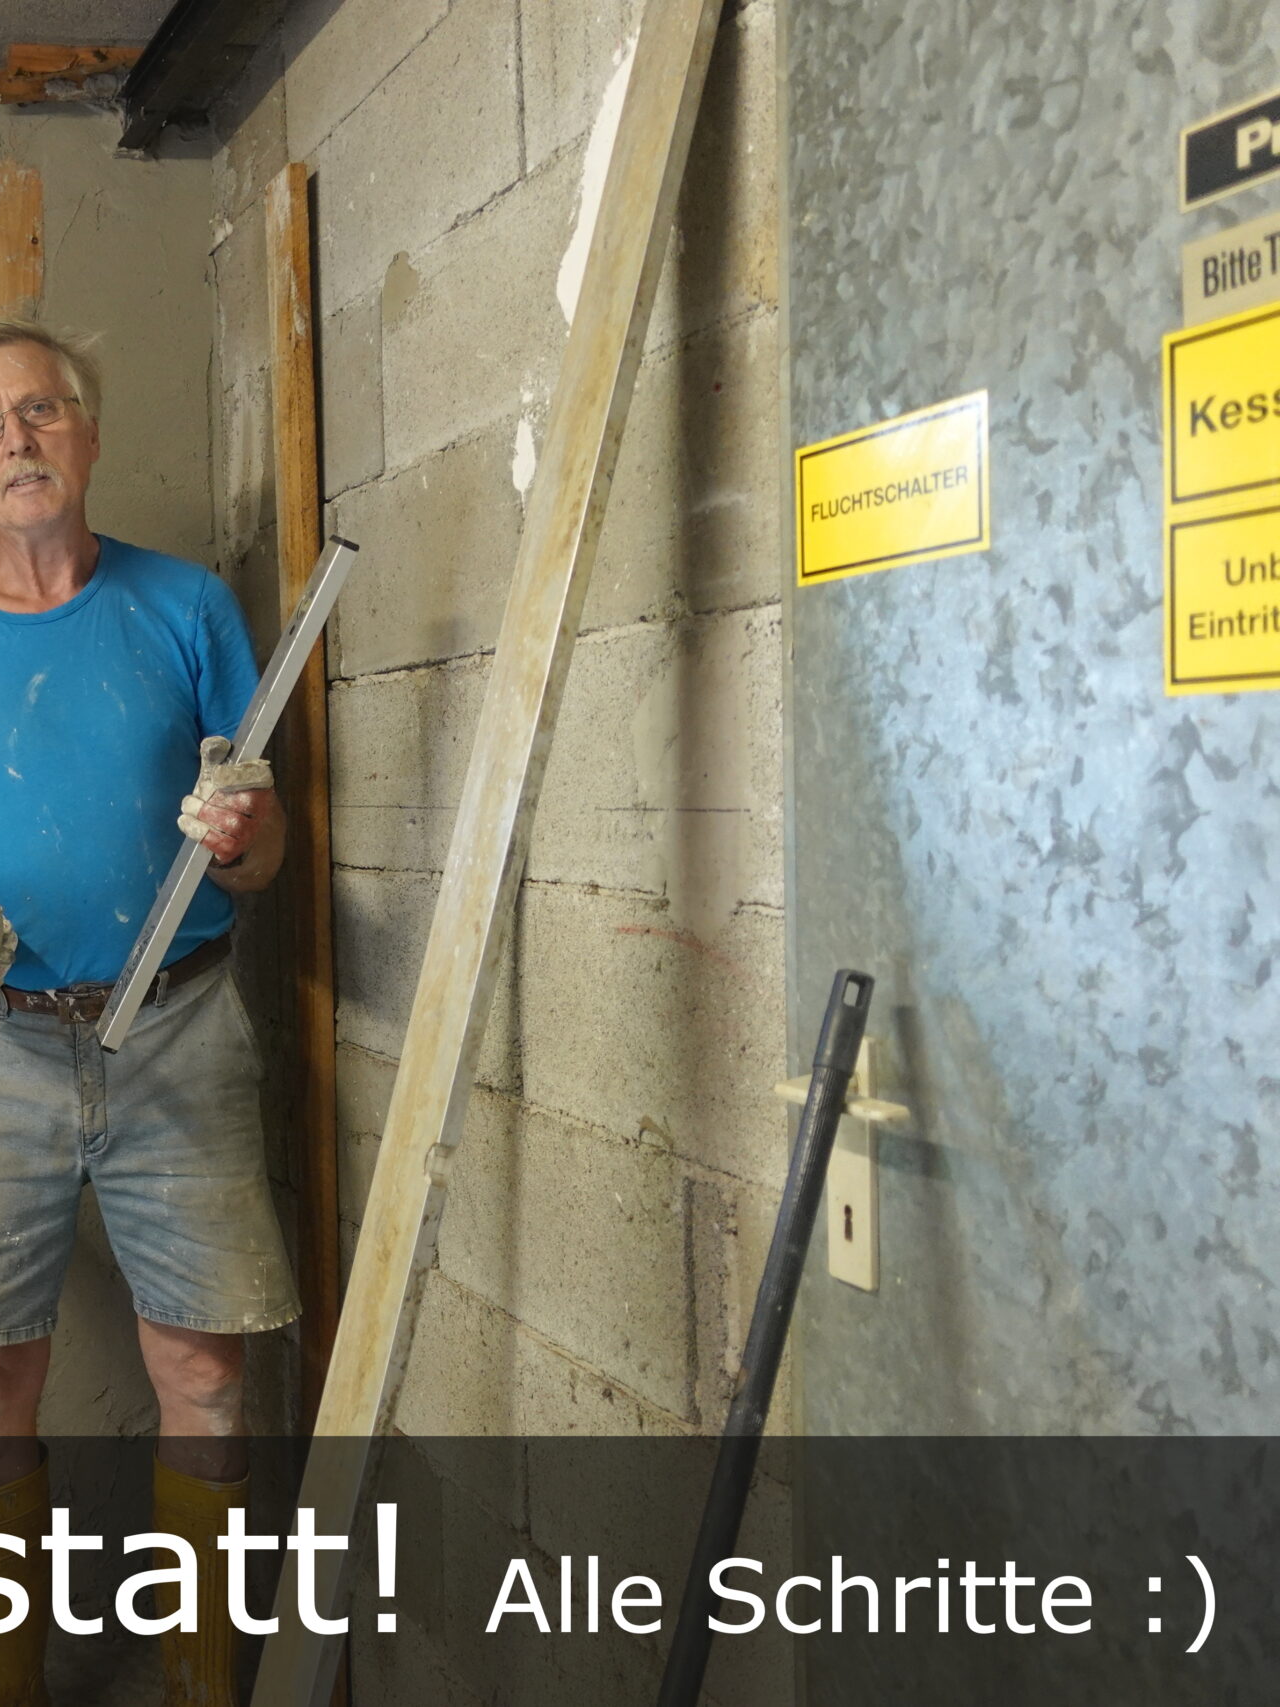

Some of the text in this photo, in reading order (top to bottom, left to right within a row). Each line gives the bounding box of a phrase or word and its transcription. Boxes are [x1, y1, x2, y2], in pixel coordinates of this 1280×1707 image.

[1203, 247, 1262, 298] Bitte
[811, 465, 969, 523] FLUCHTSCHALTER
[1188, 604, 1280, 641] Eintrit
